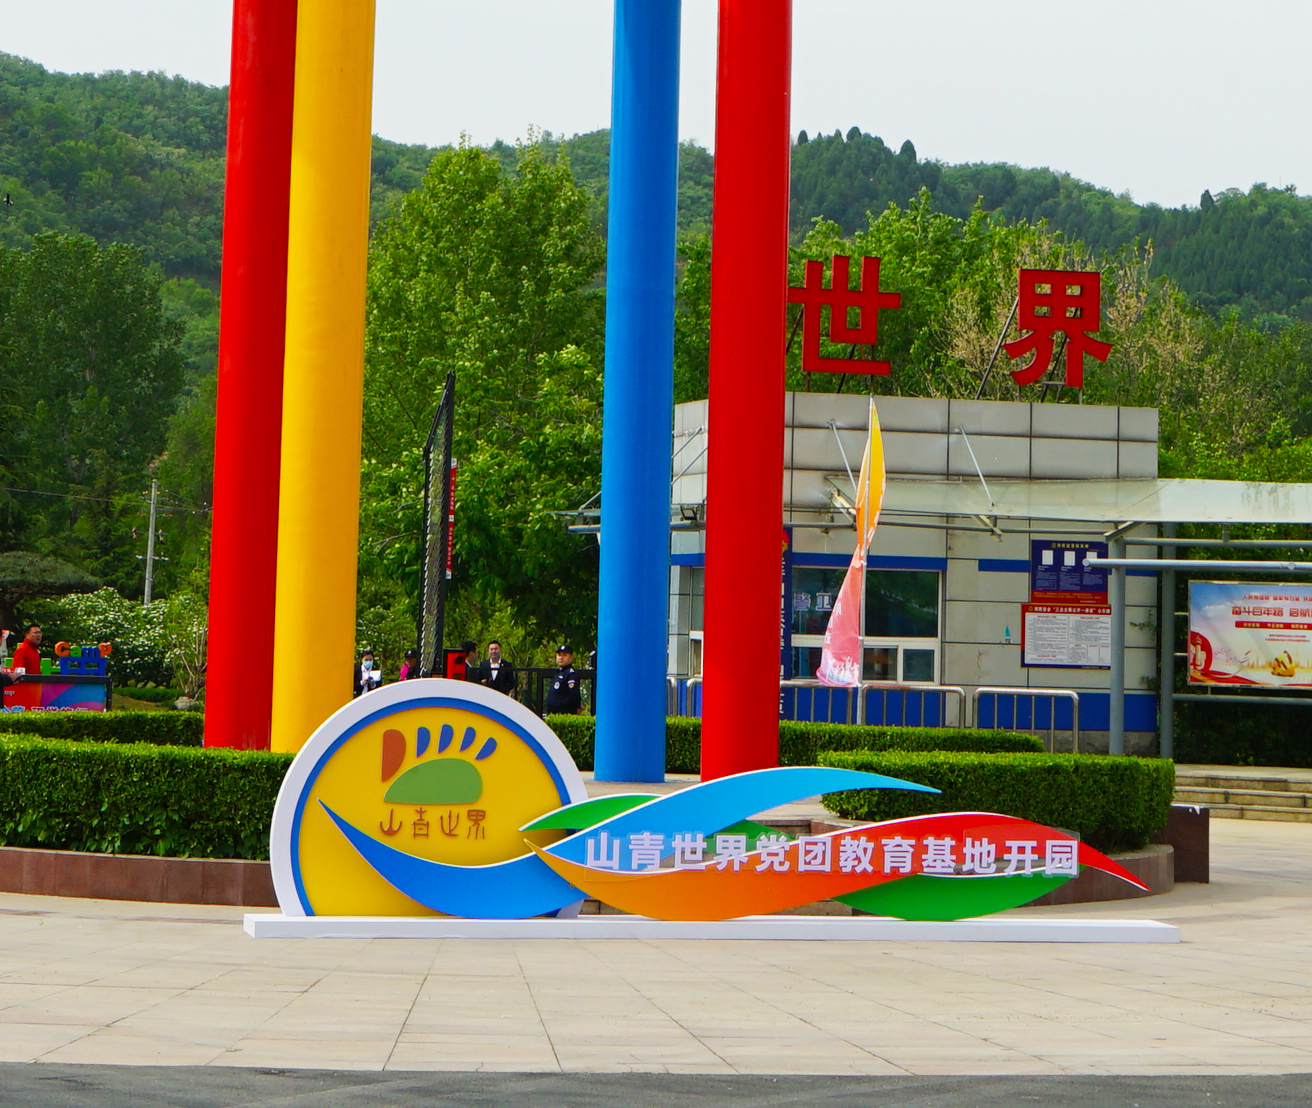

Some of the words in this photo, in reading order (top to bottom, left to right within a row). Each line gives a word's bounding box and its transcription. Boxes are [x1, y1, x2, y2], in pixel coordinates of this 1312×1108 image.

[586, 831, 1079, 876] 山青世界党团教育基地开园
